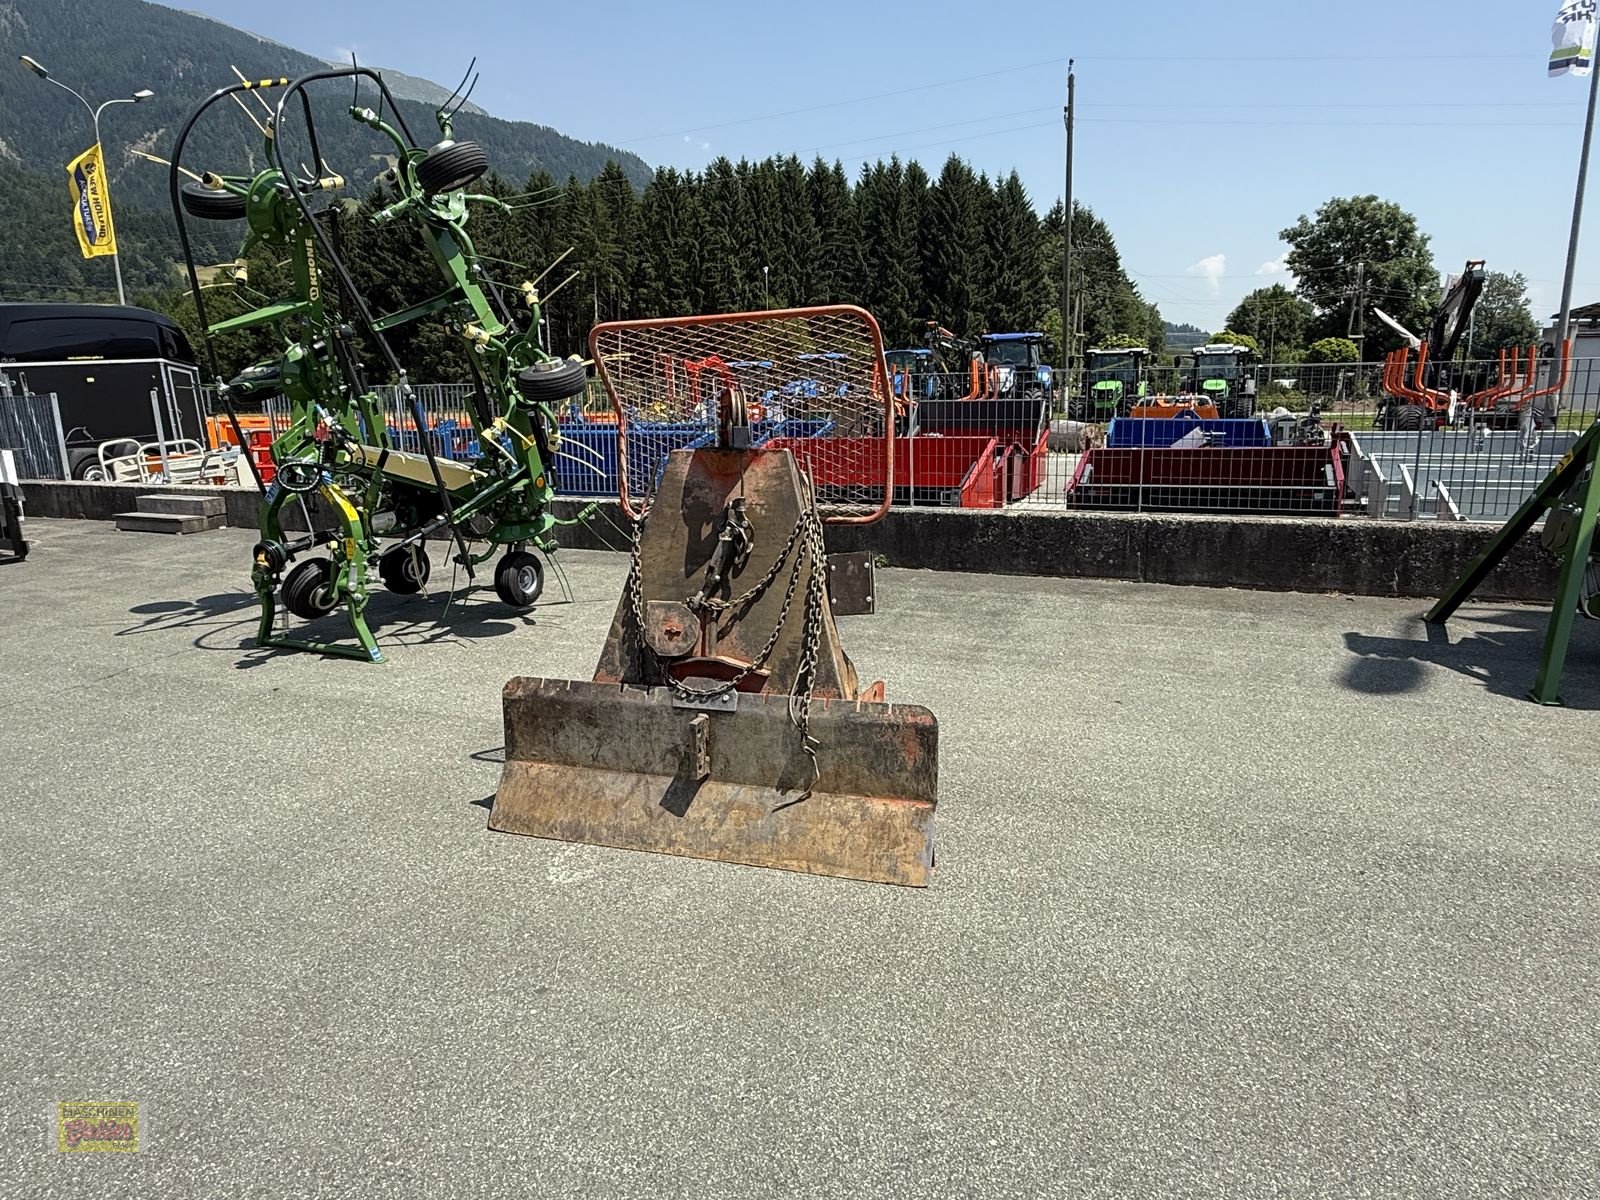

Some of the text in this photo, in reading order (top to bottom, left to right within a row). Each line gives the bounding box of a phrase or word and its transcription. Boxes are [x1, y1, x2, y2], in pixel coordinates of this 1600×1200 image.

[89, 175, 106, 238] NEW HOLLAND
[304, 238, 318, 286] KRONE
